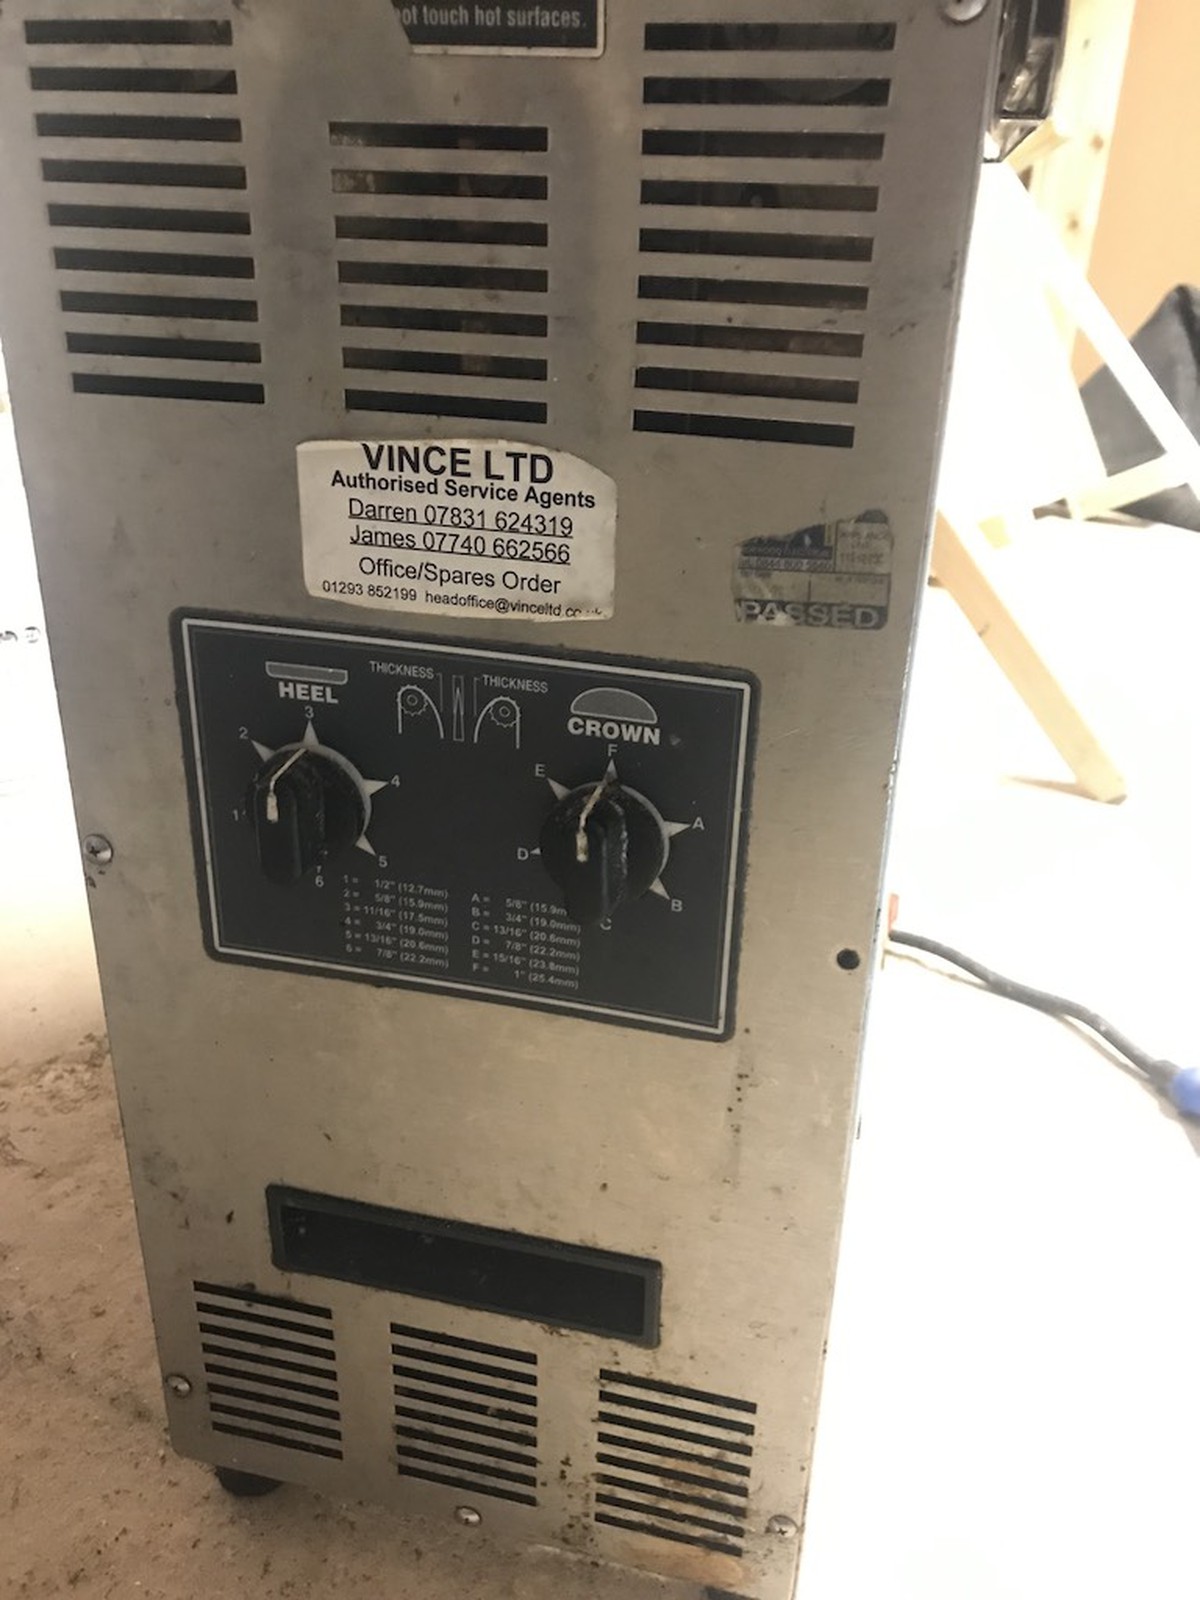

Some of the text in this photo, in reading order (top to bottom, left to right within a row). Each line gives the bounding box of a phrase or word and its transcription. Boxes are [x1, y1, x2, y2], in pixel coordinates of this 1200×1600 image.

[423, 6, 469, 25] touch
[475, 6, 501, 26] hot
[507, 6, 587, 28] surfaces.
[361, 443, 554, 483] VINCE LTD
[331, 470, 595, 508] Authorised Service Agents
[349, 498, 573, 537] Darren 07831 624319
[350, 524, 570, 564] James 07740 662566
[359, 557, 561, 594] Office/Spares Order
[322, 580, 364, 596] 01293
[367, 585, 417, 601] 852199
[742, 601, 879, 628] PASSED
[369, 661, 435, 680] THICKNESS
[482, 674, 548, 694] THICKNESS
[278, 681, 338, 704] HEEL
[304, 706, 314, 719] 3
[239, 726, 248, 740] 2
[567, 717, 661, 745] CROWN
[608, 744, 618, 757] F
[535, 763, 546, 777] E
[391, 775, 400, 787] 4
[232, 810, 239, 821] 1
[692, 817, 705, 830] A
[517, 848, 529, 860] D
[379, 855, 388, 868] 5
[315, 875, 324, 887] 6
[375, 879, 395, 889] 1/2"
[398, 883, 448, 899] (12.7mm)
[471, 893, 480, 903] A
[530, 903, 567, 916] (15.9m
[671, 900, 683, 912] B
[471, 907, 480, 917] B
[472, 921, 480, 931] C
[472, 935, 480, 944] D
[472, 949, 479, 958] E
[472, 963, 479, 972] F
